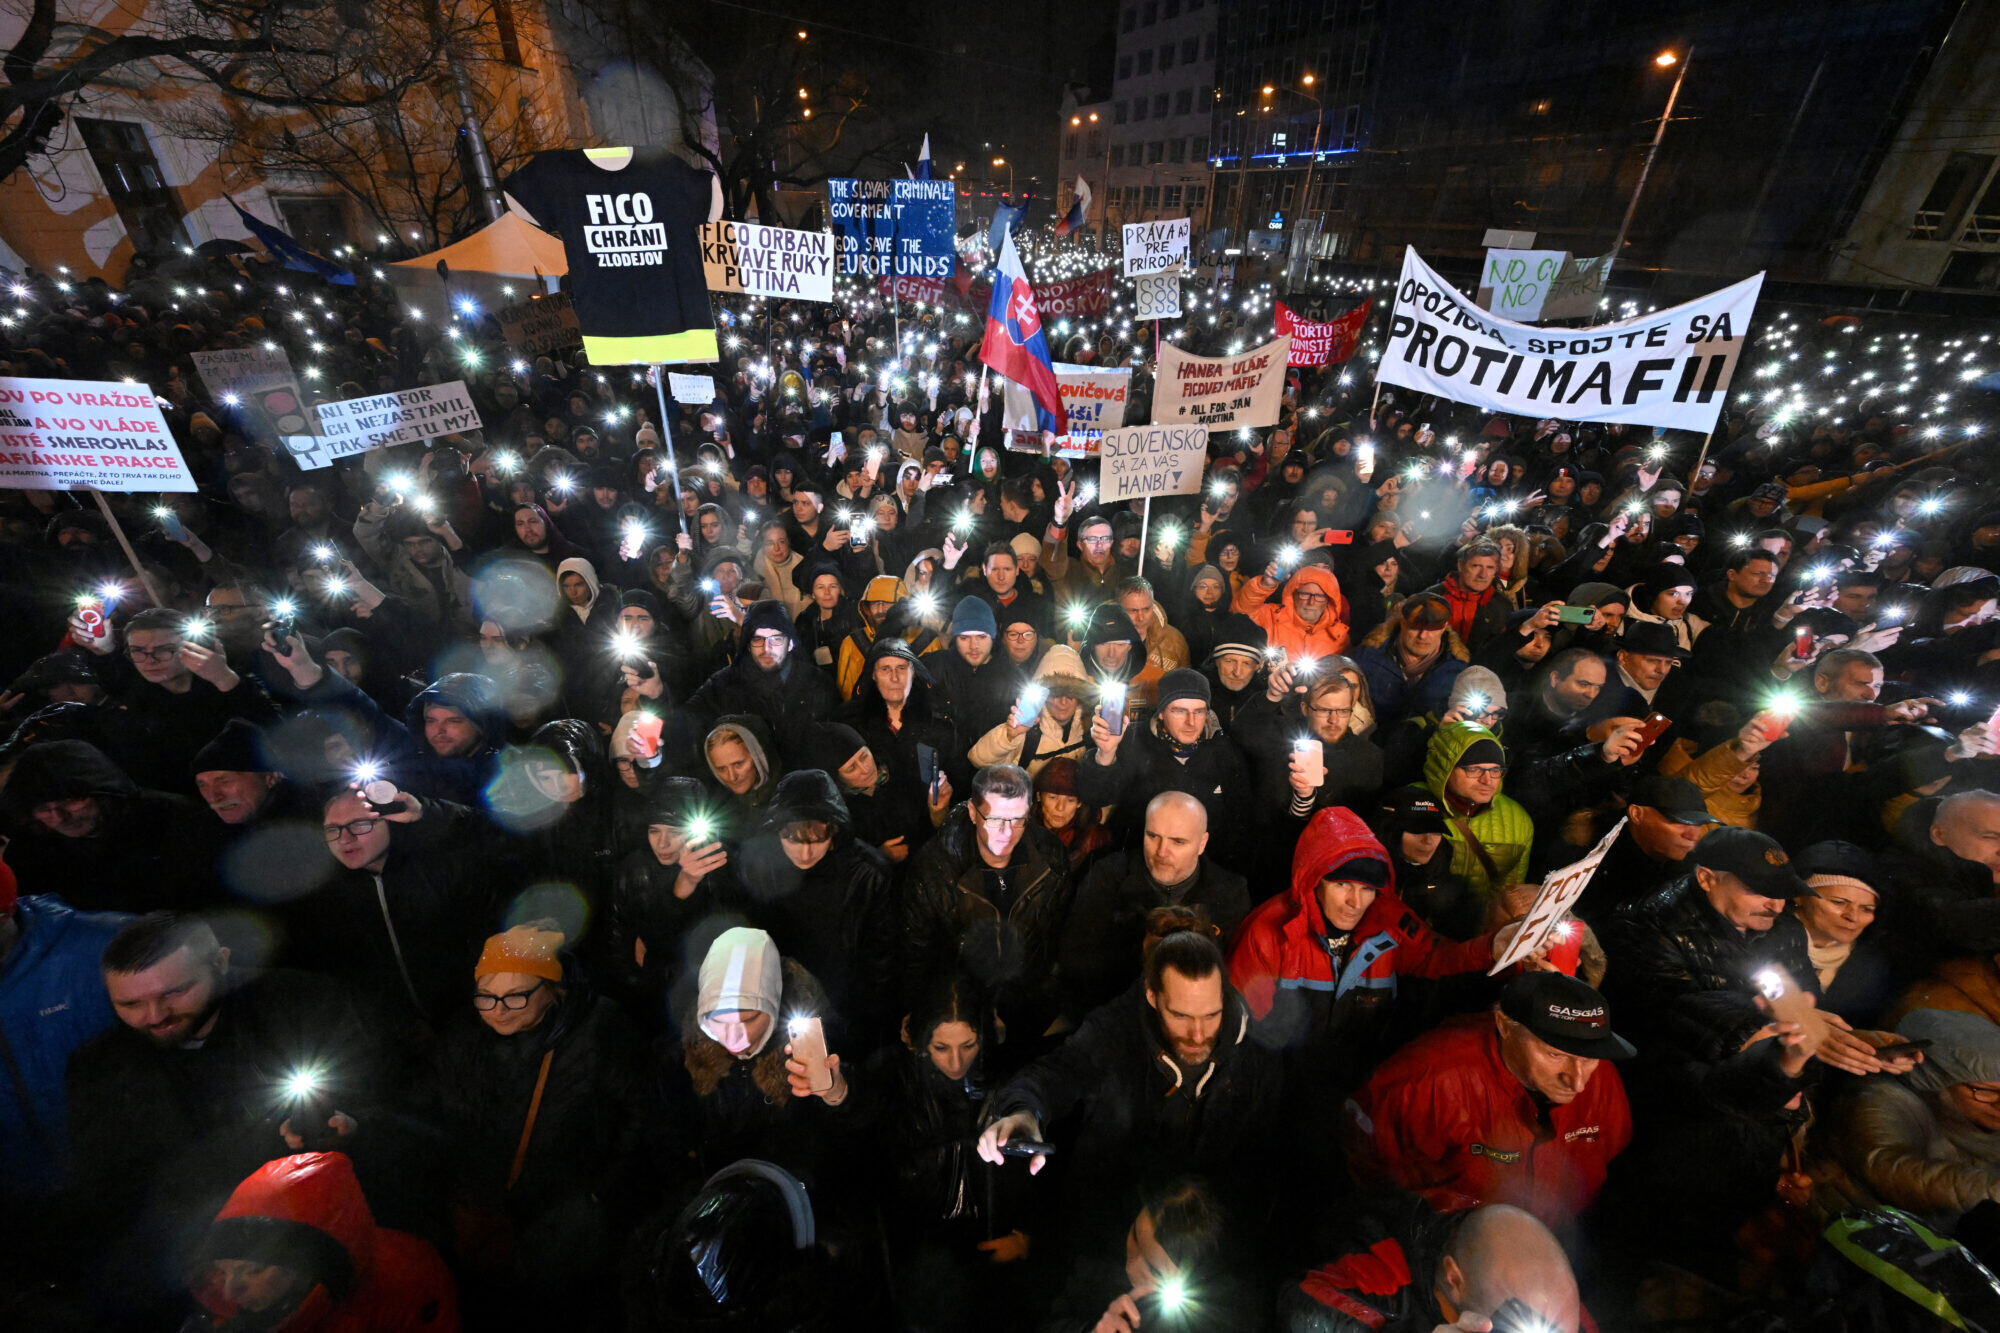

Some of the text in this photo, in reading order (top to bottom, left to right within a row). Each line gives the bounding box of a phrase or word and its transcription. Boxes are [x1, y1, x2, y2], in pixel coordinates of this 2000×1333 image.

[828, 180, 848, 198] THE
[852, 180, 891, 199] SLOVAK
[586, 192, 653, 224] FICO
[831, 203, 905, 219] GOVERMENT
[591, 224, 662, 248] CHRÁNI
[702, 221, 826, 256] FICO ORBAN
[834, 236, 922, 254] GOD SAVE THE
[1125, 223, 1174, 245] PRÁVA
[1145, 241, 1169, 254] PRE
[597, 251, 663, 267] ZLODEJOV
[702, 242, 831, 276] KRVAVE RUKY
[836, 254, 950, 276] EUROFUNDS
[1130, 246, 1188, 272] PRÍRODU!
[725, 266, 800, 293] PUTINA
[1489, 259, 1526, 283] NO
[1036, 294, 1110, 314] MOSKVA
[1501, 283, 1538, 308] NO
[1685, 312, 1733, 344] SA
[1177, 361, 1223, 379] HANBA
[1390, 314, 1727, 406] PROTI MAFII
[1058, 381, 1126, 402] ovičová
[1182, 373, 1262, 398] FICOVEJ MAFIE!
[29, 391, 64, 405] PO
[67, 390, 154, 408] VRAŽDE
[350, 389, 432, 415] SEMAFOR
[1190, 404, 1206, 415] ALL
[1209, 402, 1227, 413] FOR
[1230, 397, 1251, 410] JAN
[356, 398, 470, 431] NEZASTAVIL
[1066, 402, 1103, 421] úši!
[1198, 411, 1235, 424] MARTINA
[35, 417, 160, 433] A VO VLÁDE
[327, 409, 480, 456] TAK SME TU MY!
[47, 436, 168, 450] SMEROHLAS
[1105, 428, 1207, 458] SLOVENSKO
[99, 455, 179, 469] PRASCE
[1112, 451, 1180, 475] SA ZA VÁS
[1549, 1004, 1604, 1017] GASGAS
